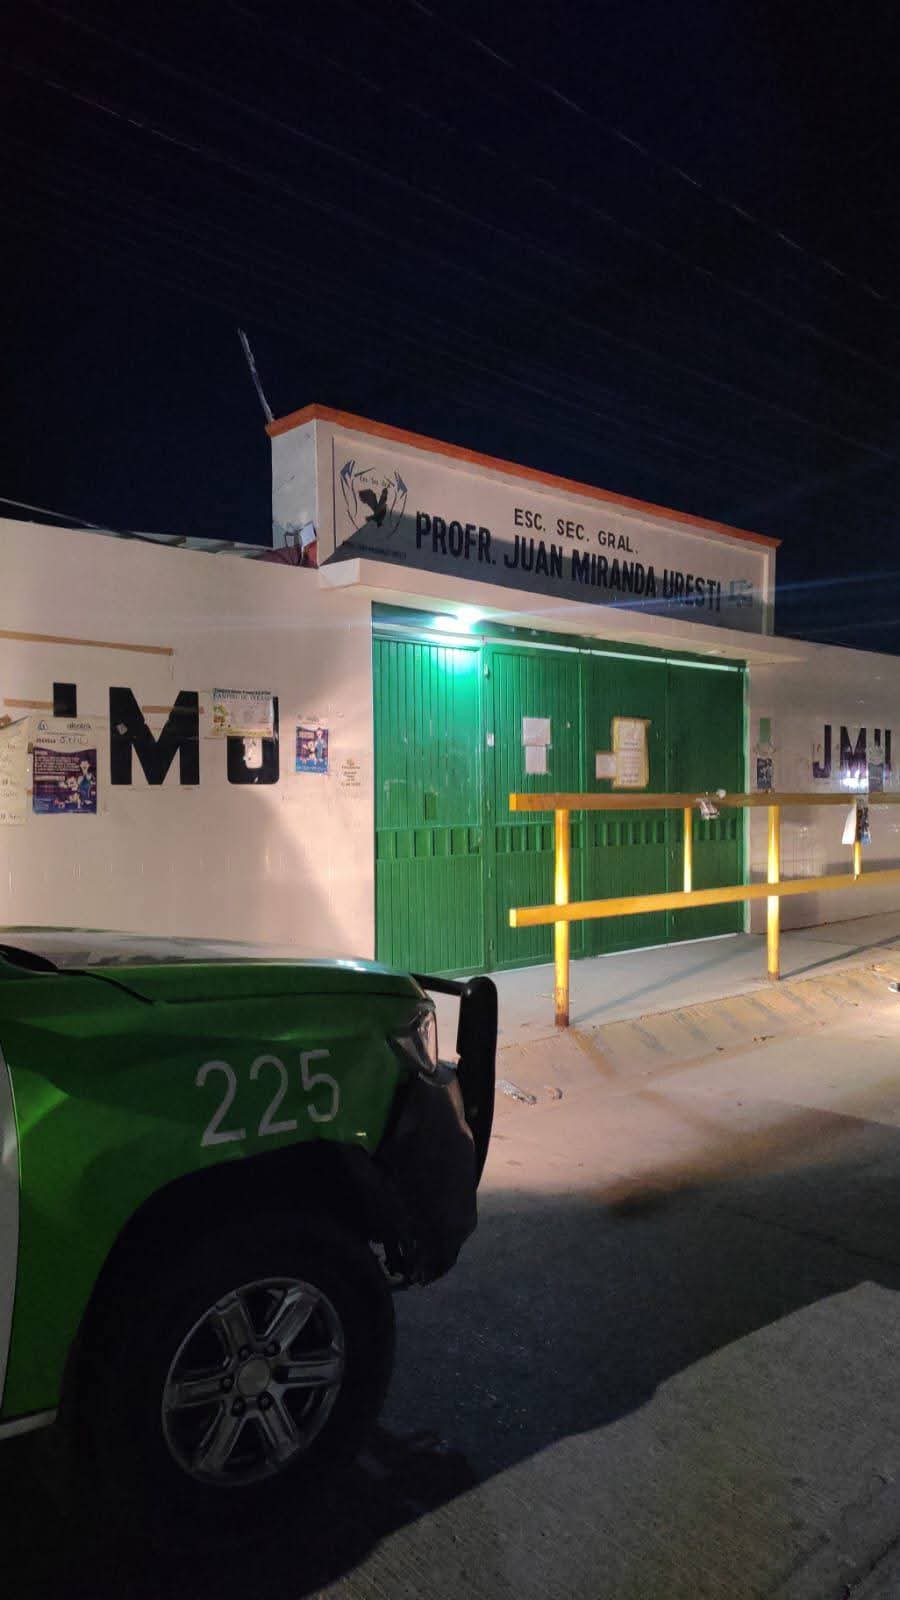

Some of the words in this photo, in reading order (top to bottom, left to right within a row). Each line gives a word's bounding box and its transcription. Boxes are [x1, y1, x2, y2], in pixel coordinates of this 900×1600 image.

[416, 511, 497, 565] PROFR.
[504, 535, 563, 580] JUAN
[571, 549, 657, 598] MIRANDA
[662, 568, 721, 612] URESTI
[514, 508, 546, 532] ESC.
[556, 519, 590, 542] SEC.
[598, 530, 639, 554] GRAL.
[195, 1049, 340, 1147] 225
